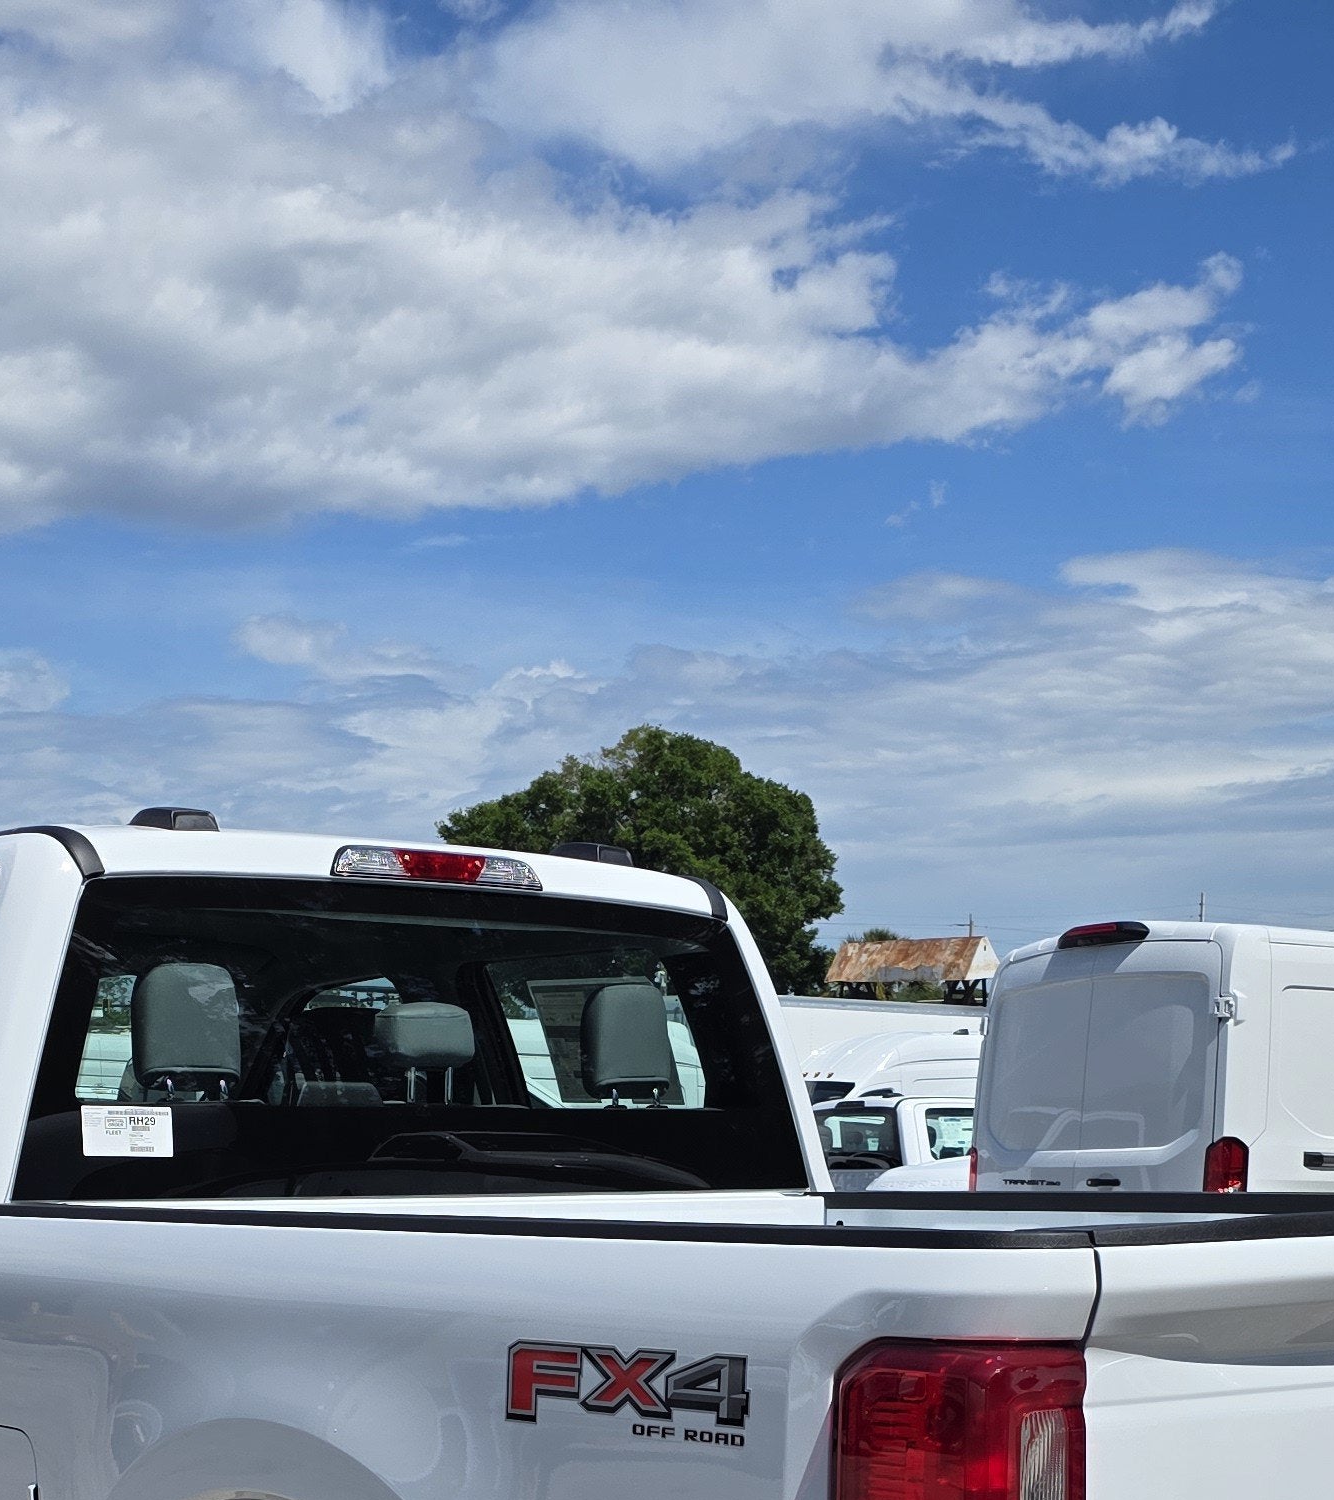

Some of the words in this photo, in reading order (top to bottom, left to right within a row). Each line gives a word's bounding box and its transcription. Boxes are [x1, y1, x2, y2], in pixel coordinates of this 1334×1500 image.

[505, 1338, 752, 1428] FX4
[631, 1423, 675, 1440] OFF
[683, 1428, 746, 1448] ROAD
